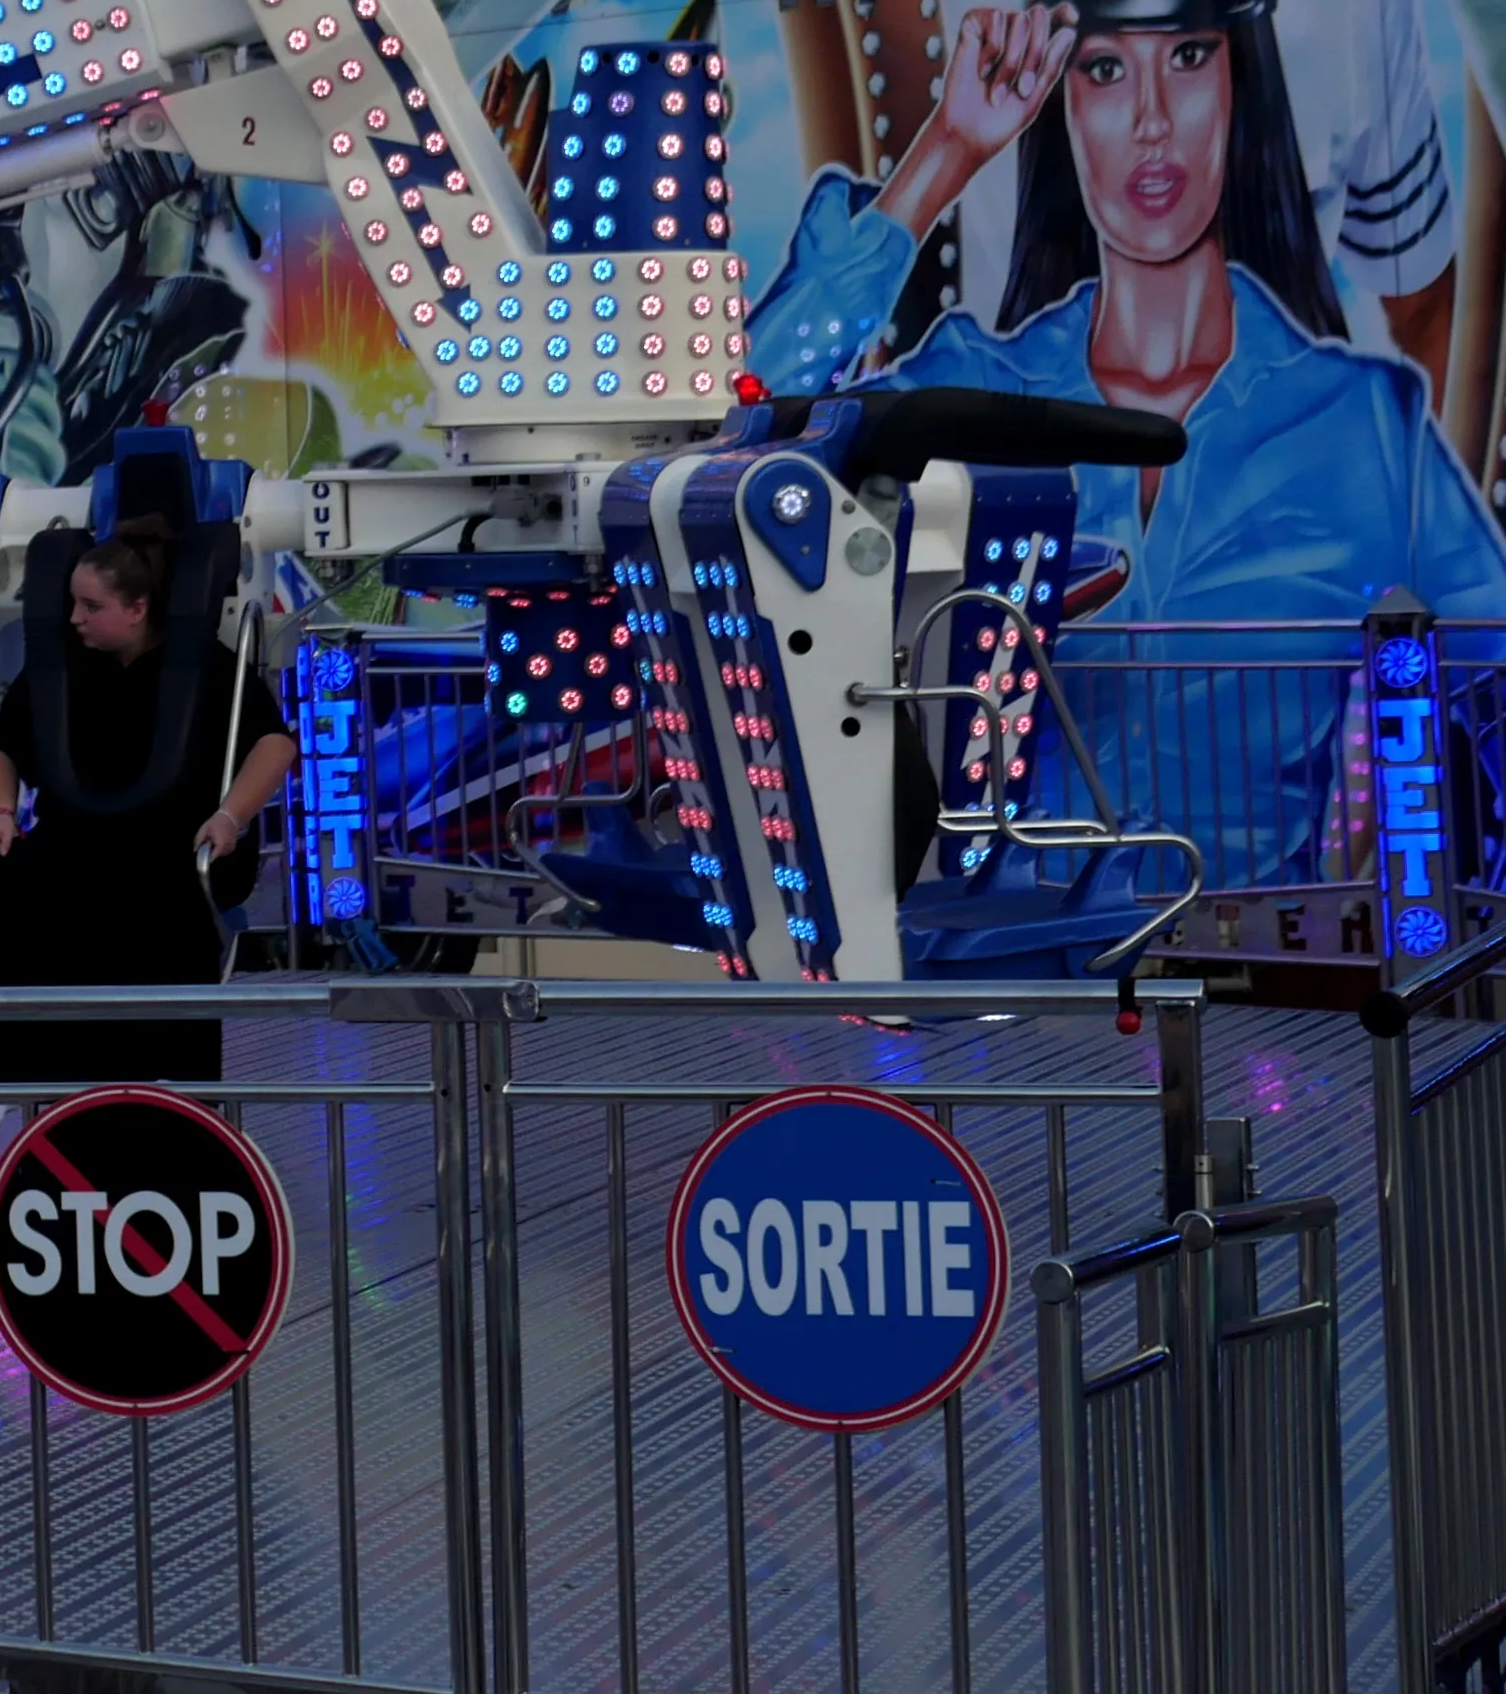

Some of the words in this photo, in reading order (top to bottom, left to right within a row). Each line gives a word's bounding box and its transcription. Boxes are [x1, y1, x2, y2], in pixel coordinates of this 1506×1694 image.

[241, 118, 256, 148] 2
[312, 481, 331, 548] OUT
[315, 699, 363, 870] JET
[1378, 698, 1447, 898] JET
[6, 1189, 256, 1298] STOP
[698, 1195, 976, 1318] SORTIE
